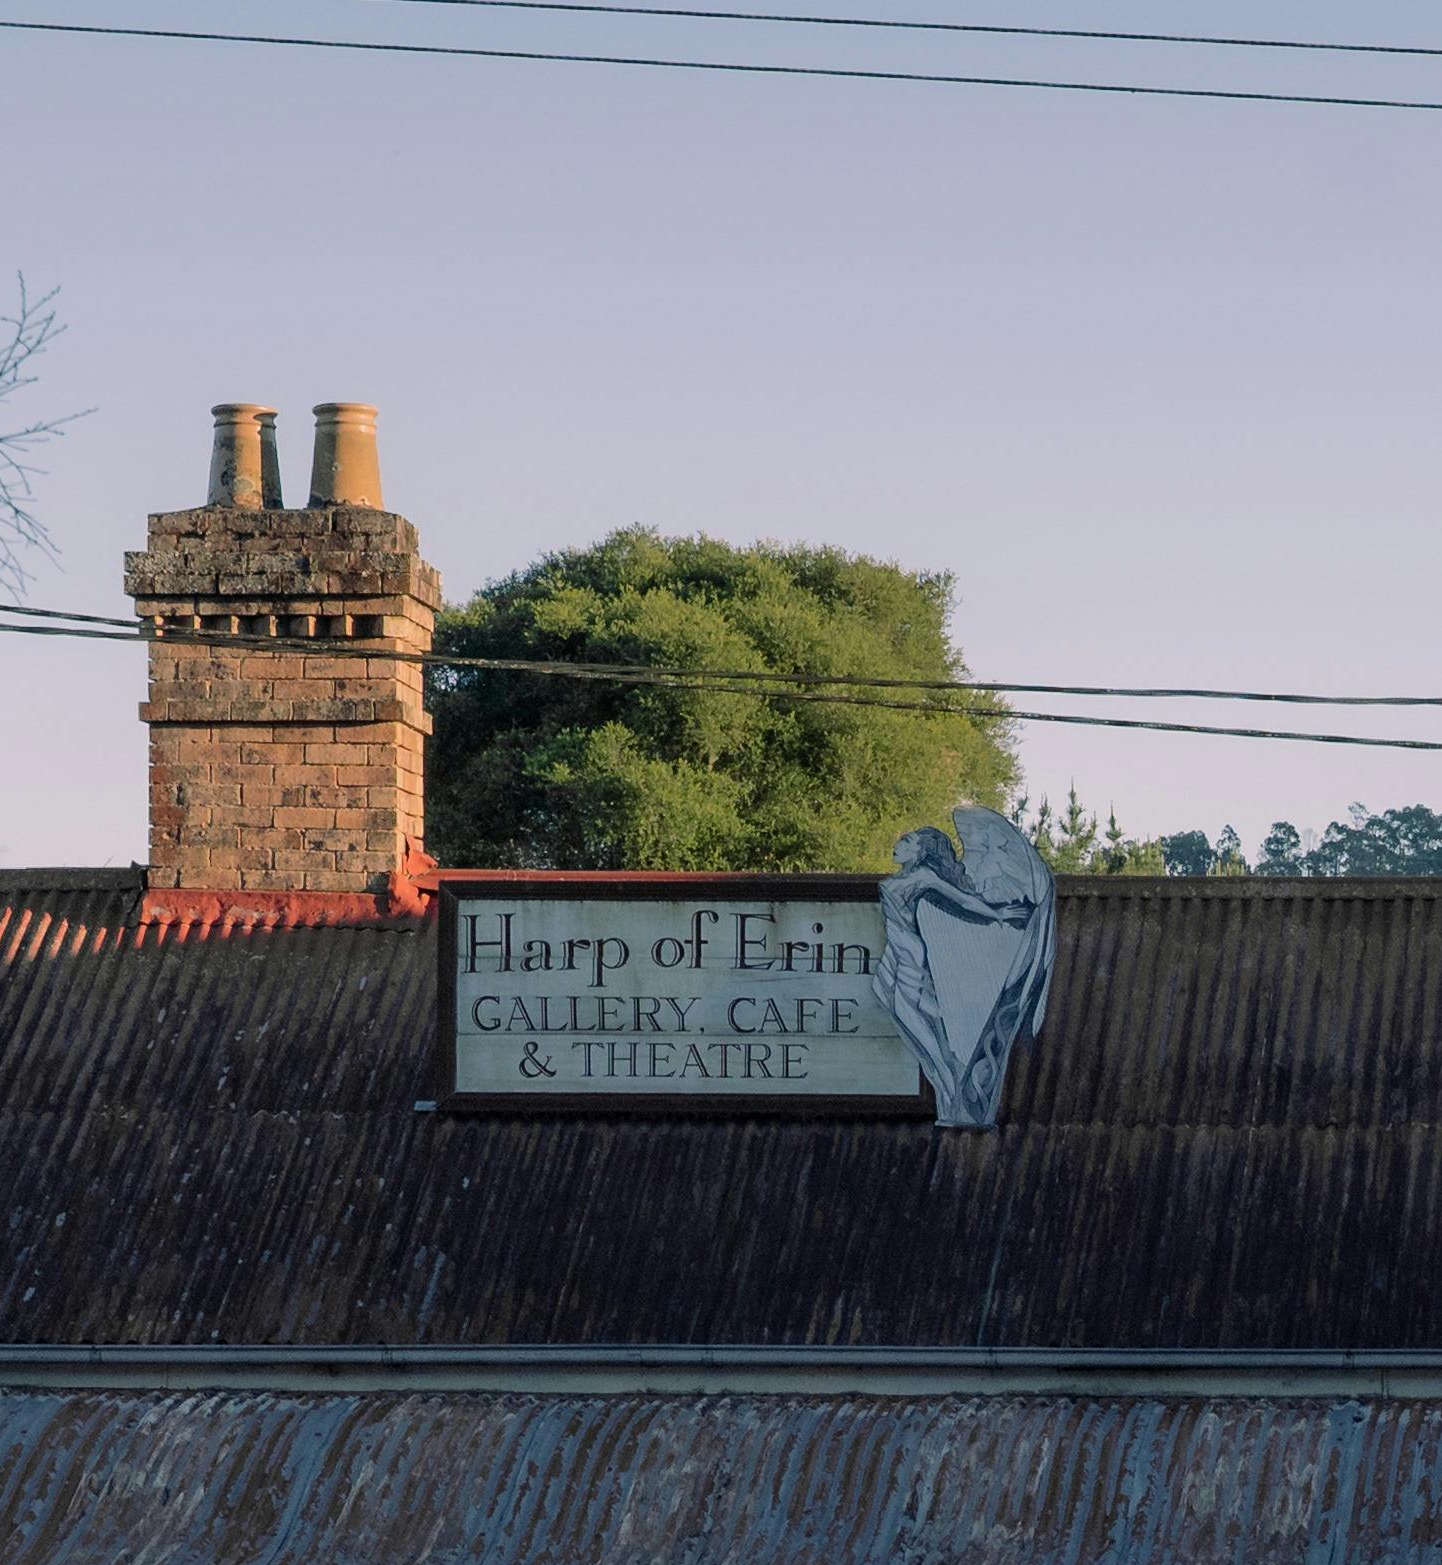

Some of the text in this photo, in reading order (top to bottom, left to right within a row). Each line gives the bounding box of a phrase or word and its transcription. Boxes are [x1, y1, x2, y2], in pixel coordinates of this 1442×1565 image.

[462, 909, 875, 988] Harp of Erin
[471, 994, 860, 1036] GALLERY, CAFE
[518, 1040, 810, 1080] & THEATRE
